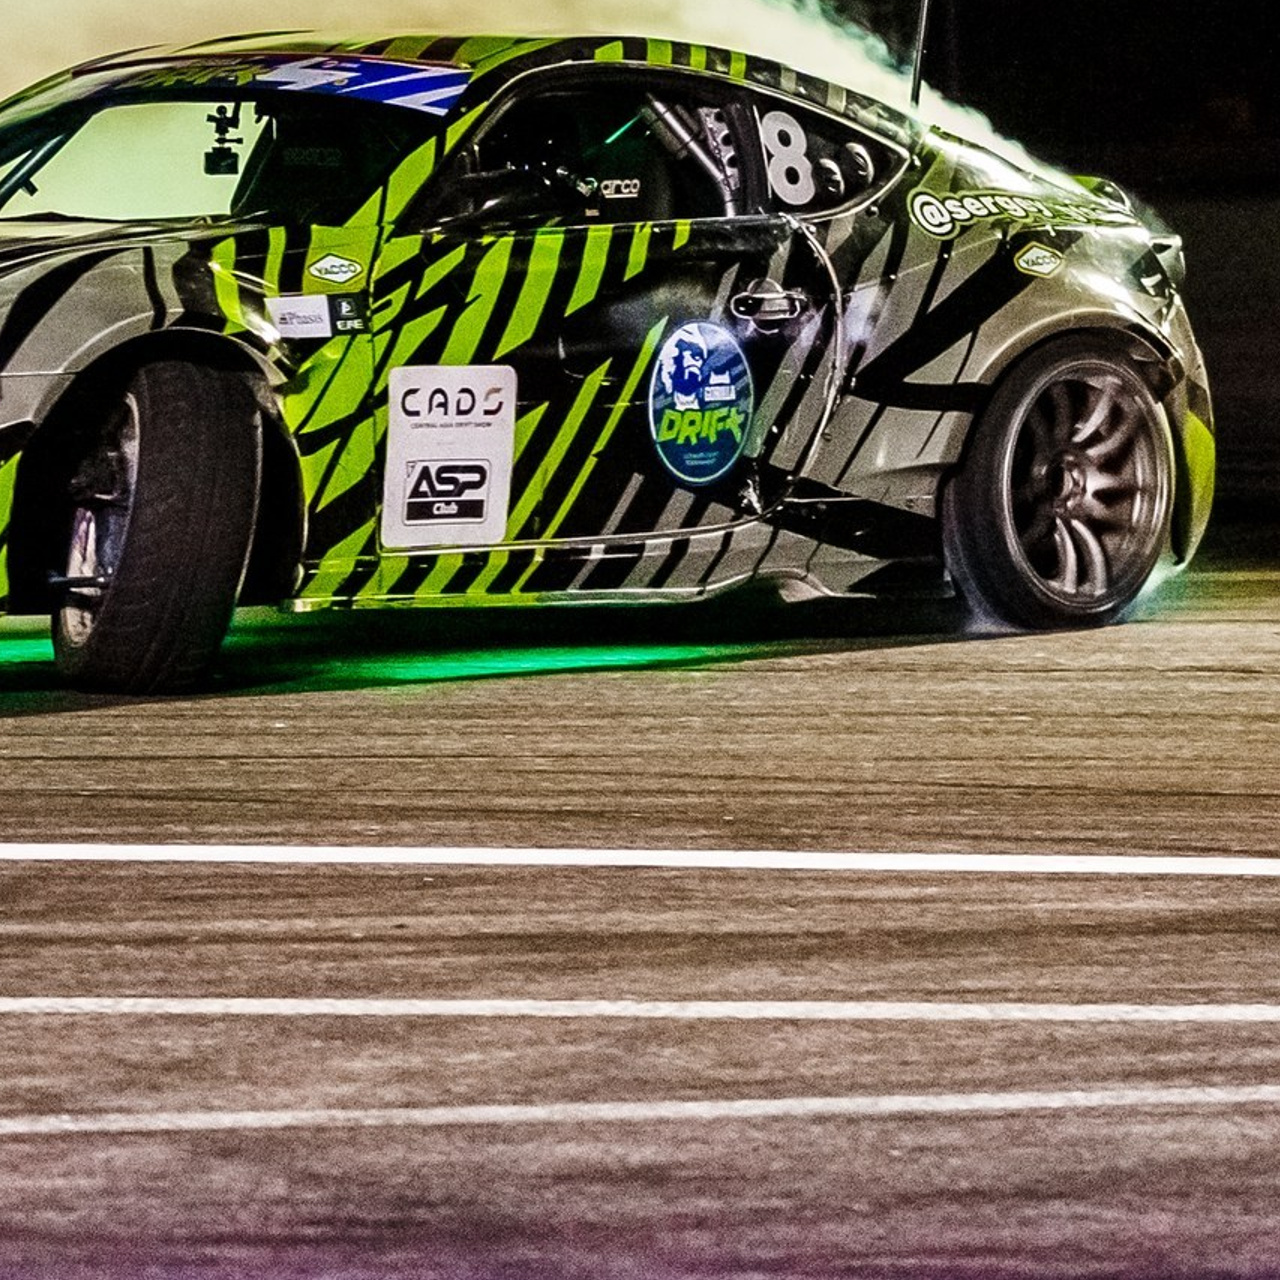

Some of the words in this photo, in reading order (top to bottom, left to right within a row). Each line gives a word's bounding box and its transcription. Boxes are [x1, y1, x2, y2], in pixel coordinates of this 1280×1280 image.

[762, 111, 816, 206] 8
[600, 178, 640, 198] arco
[314, 263, 358, 276] YACCO
[1023, 254, 1058, 268] YACCO
[401, 387, 504, 417] CADS
[657, 407, 746, 446] DRIFT
[408, 465, 487, 499] ASP
